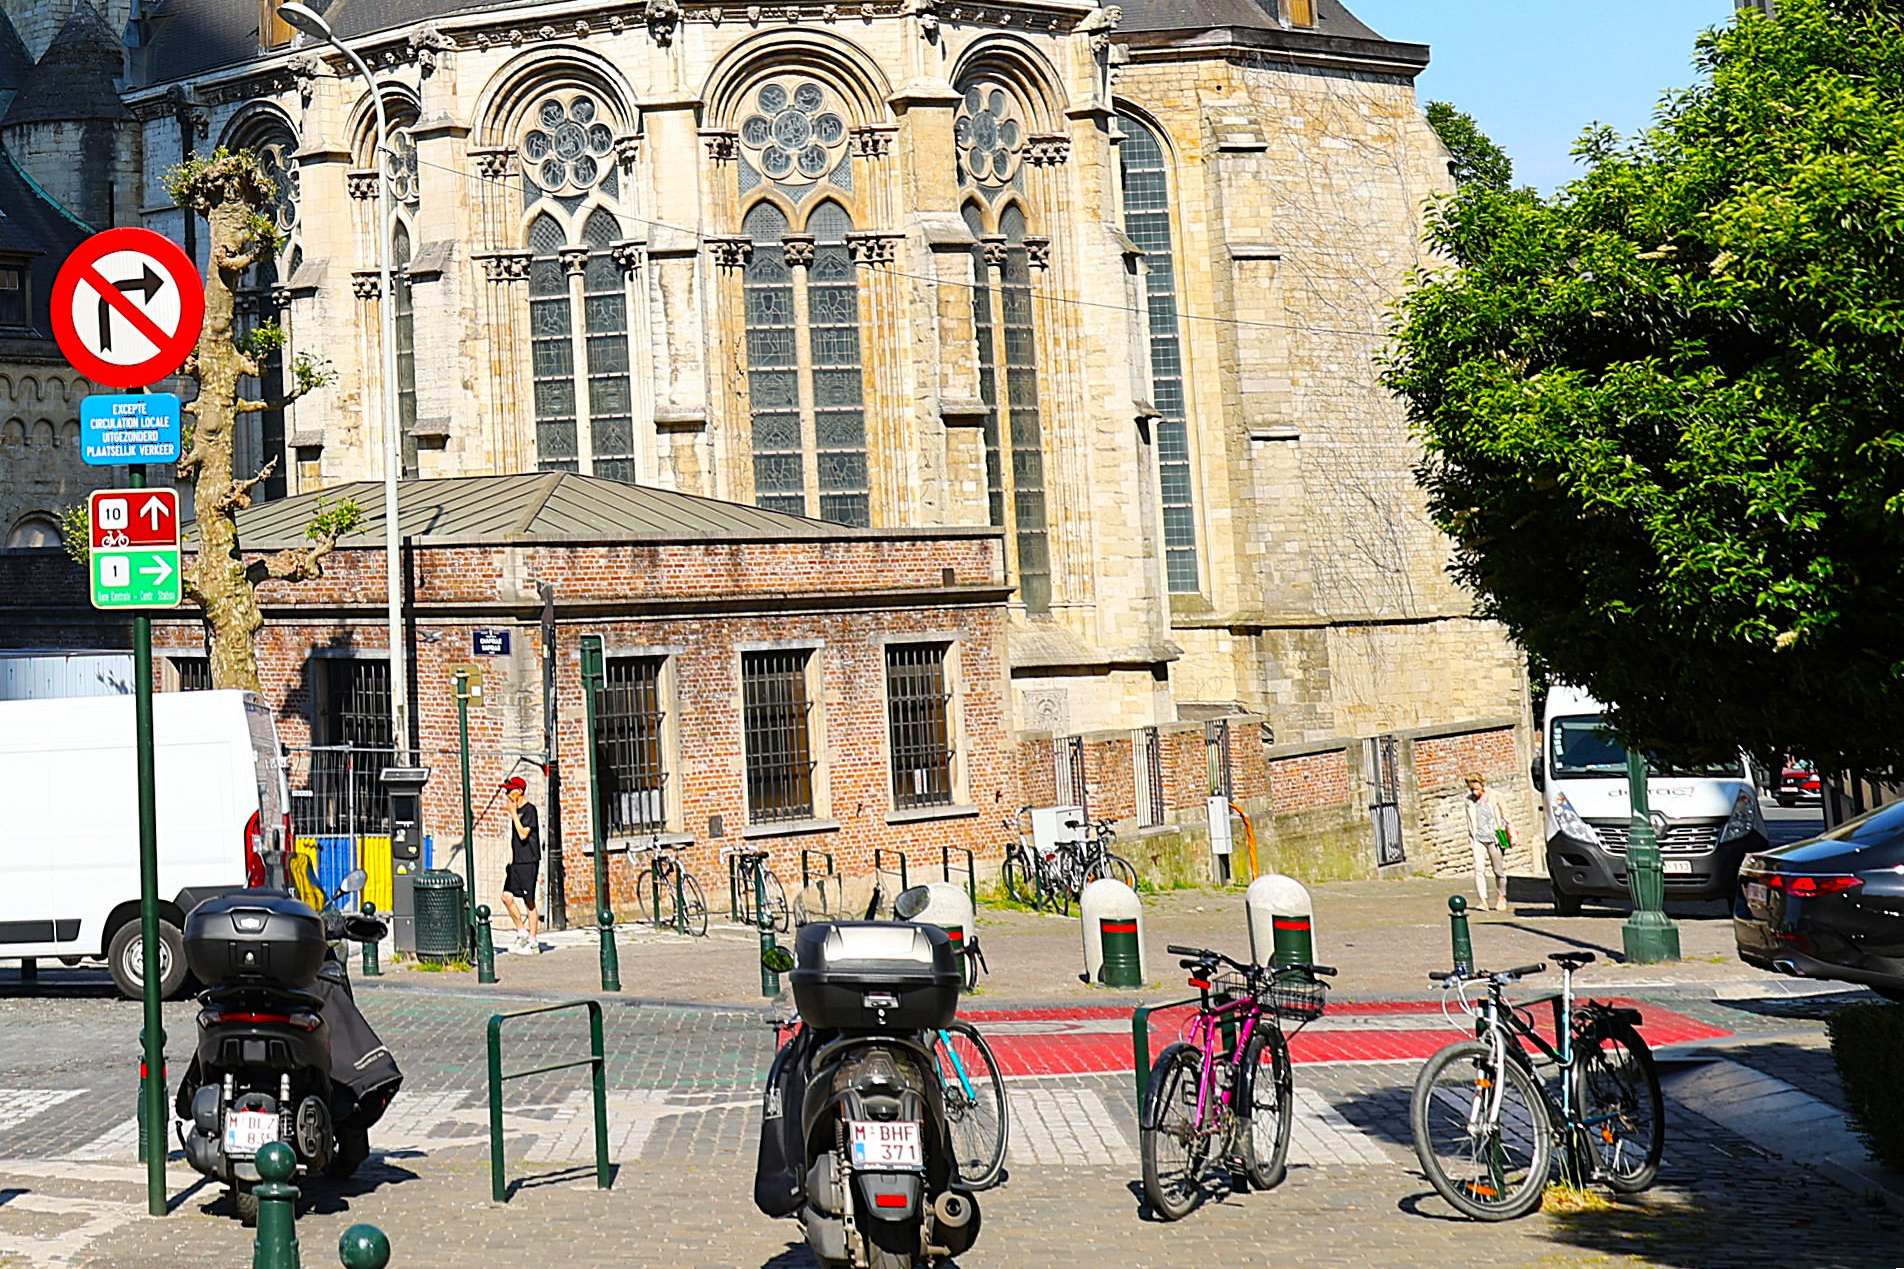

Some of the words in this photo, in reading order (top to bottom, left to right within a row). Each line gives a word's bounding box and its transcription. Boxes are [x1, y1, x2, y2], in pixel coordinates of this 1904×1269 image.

[90, 418, 139, 429] CIRCULATION
[141, 416, 170, 428] LOCALE
[102, 431, 159, 443] UITGEZONDERD
[86, 445, 137, 457] PLAATSELIJK
[139, 444, 175, 456] VERKEER
[106, 508, 121, 520] 10
[113, 565, 118, 577] 1
[881, 1144, 916, 1160] 371
